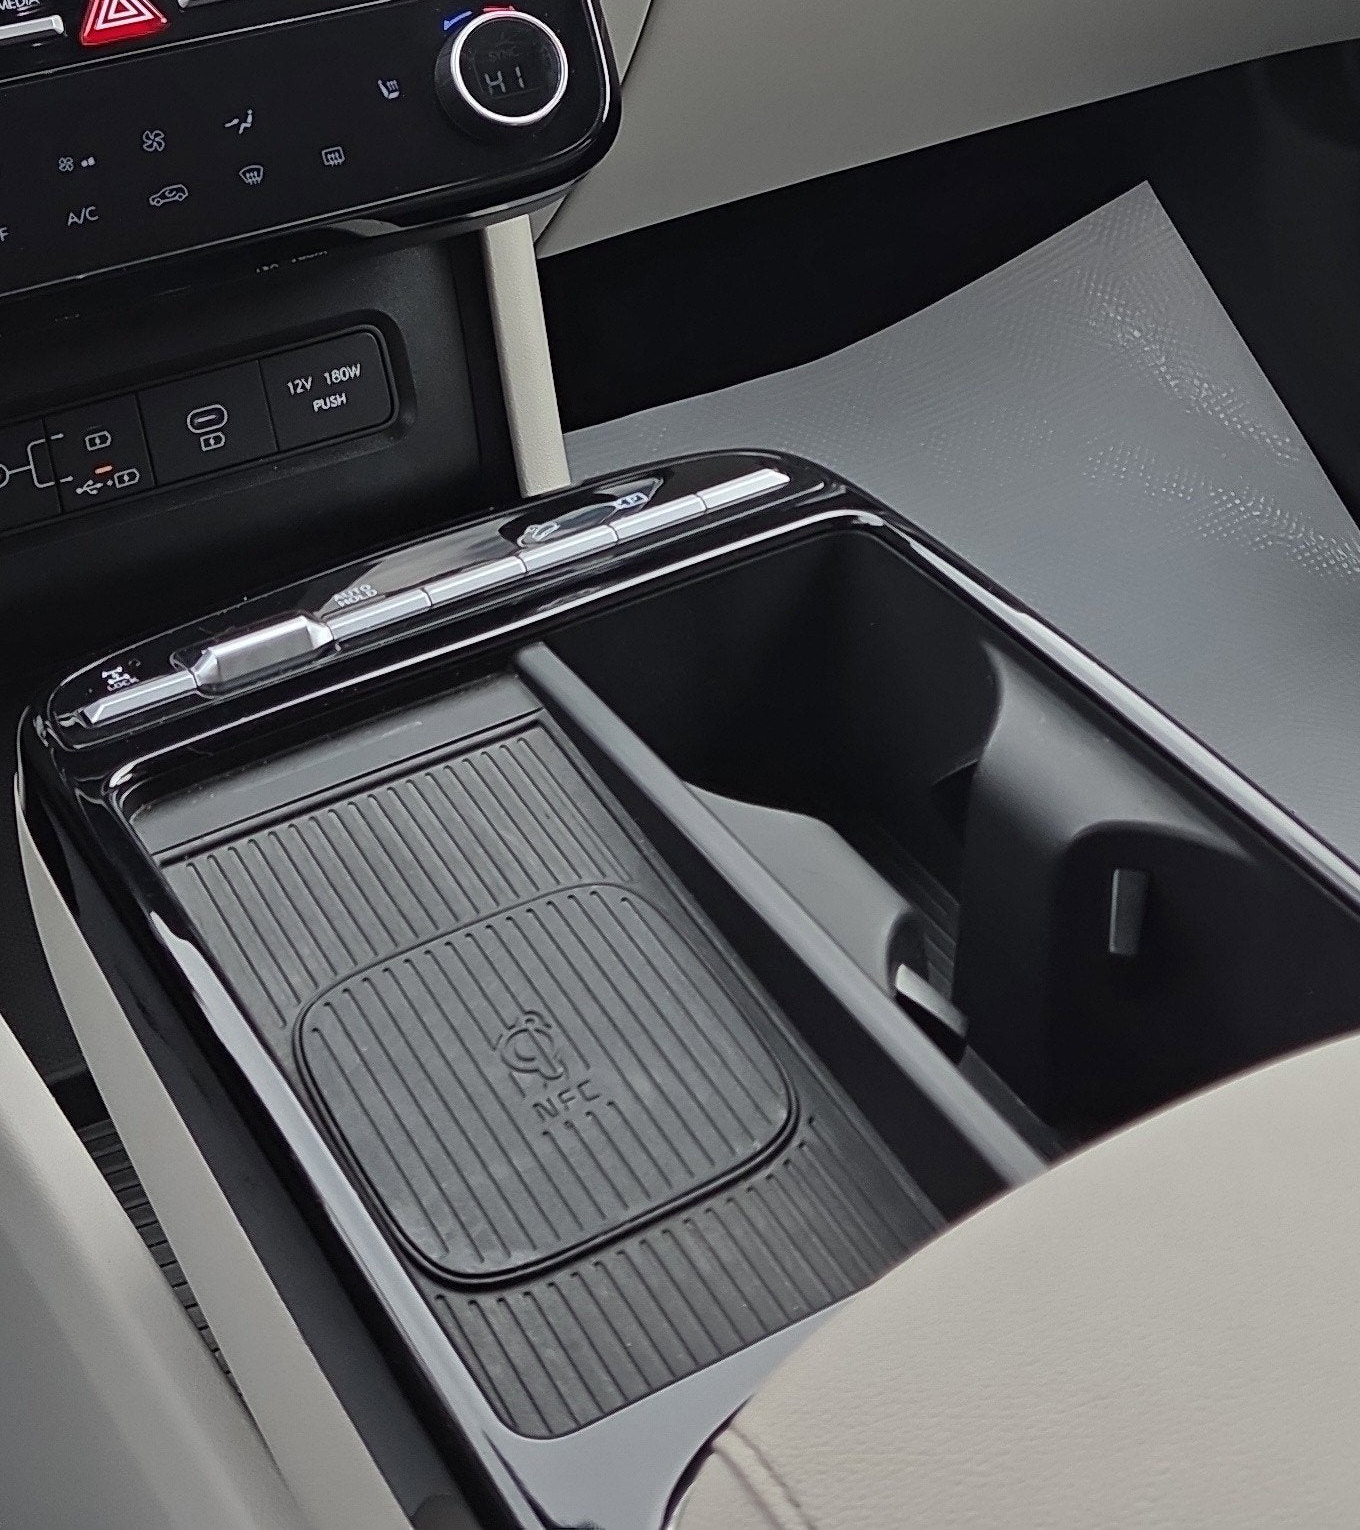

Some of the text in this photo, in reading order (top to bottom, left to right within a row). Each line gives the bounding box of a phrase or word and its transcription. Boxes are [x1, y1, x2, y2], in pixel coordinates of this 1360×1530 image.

[67, 207, 99, 226] A/C
[286, 362, 361, 396] 12V 180W
[312, 392, 347, 413] PUSH
[532, 1079, 601, 1122] NFC
